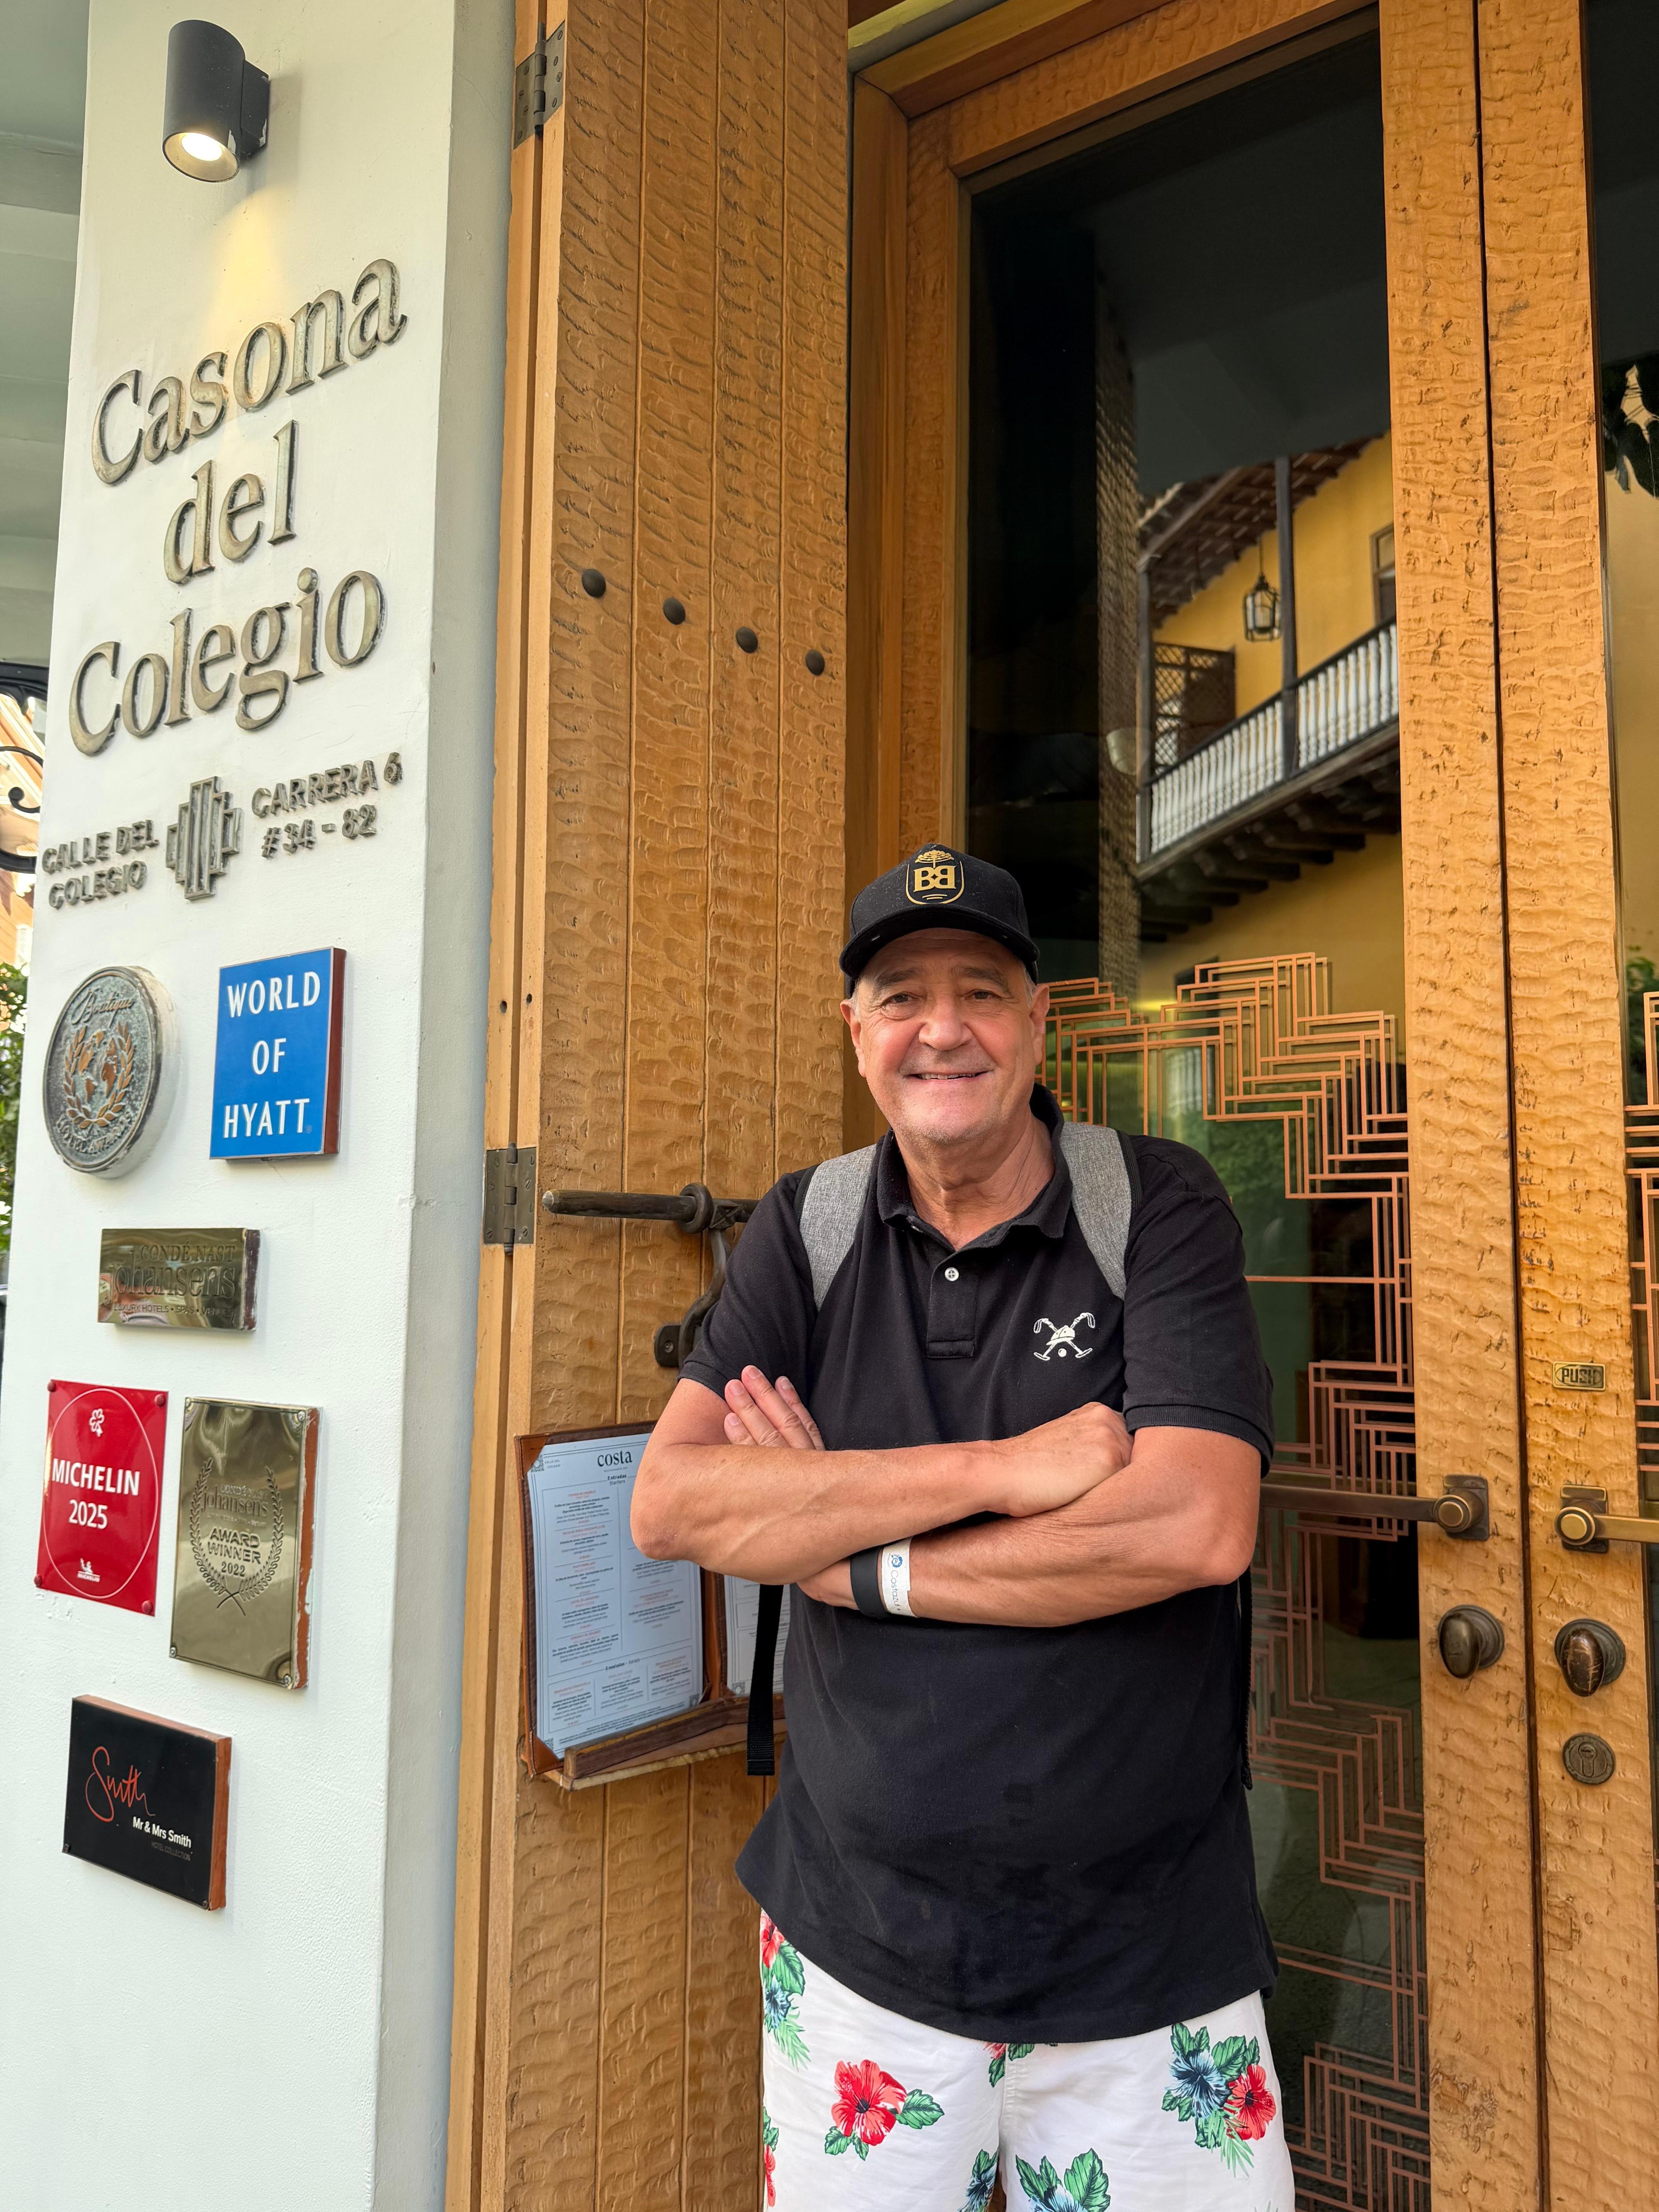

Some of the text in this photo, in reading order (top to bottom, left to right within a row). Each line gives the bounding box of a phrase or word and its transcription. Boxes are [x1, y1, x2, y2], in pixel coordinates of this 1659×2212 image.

[92, 259, 407, 485] Casona
[164, 420, 298, 584] del
[69, 567, 386, 756] Colegio
[252, 752, 403, 818] CARRERA 6
[342, 804, 377, 839] 82
[42, 820, 159, 874] CALLE DEL
[49, 860, 147, 909] COLEGIO
[71, 988, 135, 1028] Boutique
[227, 971, 320, 1018] WORLD
[252, 1038, 286, 1075] OF
[223, 1098, 310, 1139] HYATT
[141, 1242, 235, 1262] CONDÉ NAST
[114, 1304, 140, 1312] LUXURY
[142, 1305, 169, 1313] HOTELS
[176, 1306, 194, 1314] SPAS
[1561, 1368, 1595, 1384] PUSH
[598, 1450, 632, 1467] costa
[51, 1458, 140, 1496] MICHELIN
[69, 1499, 108, 1529] 2025
[201, 1485, 268, 1517] johansens
[208, 1541, 261, 1565] WINNER
[210, 1527, 260, 1549] AWARD
[221, 1561, 245, 1577] 2022
[133, 1816, 191, 1848] Mr & Mrs Smith
